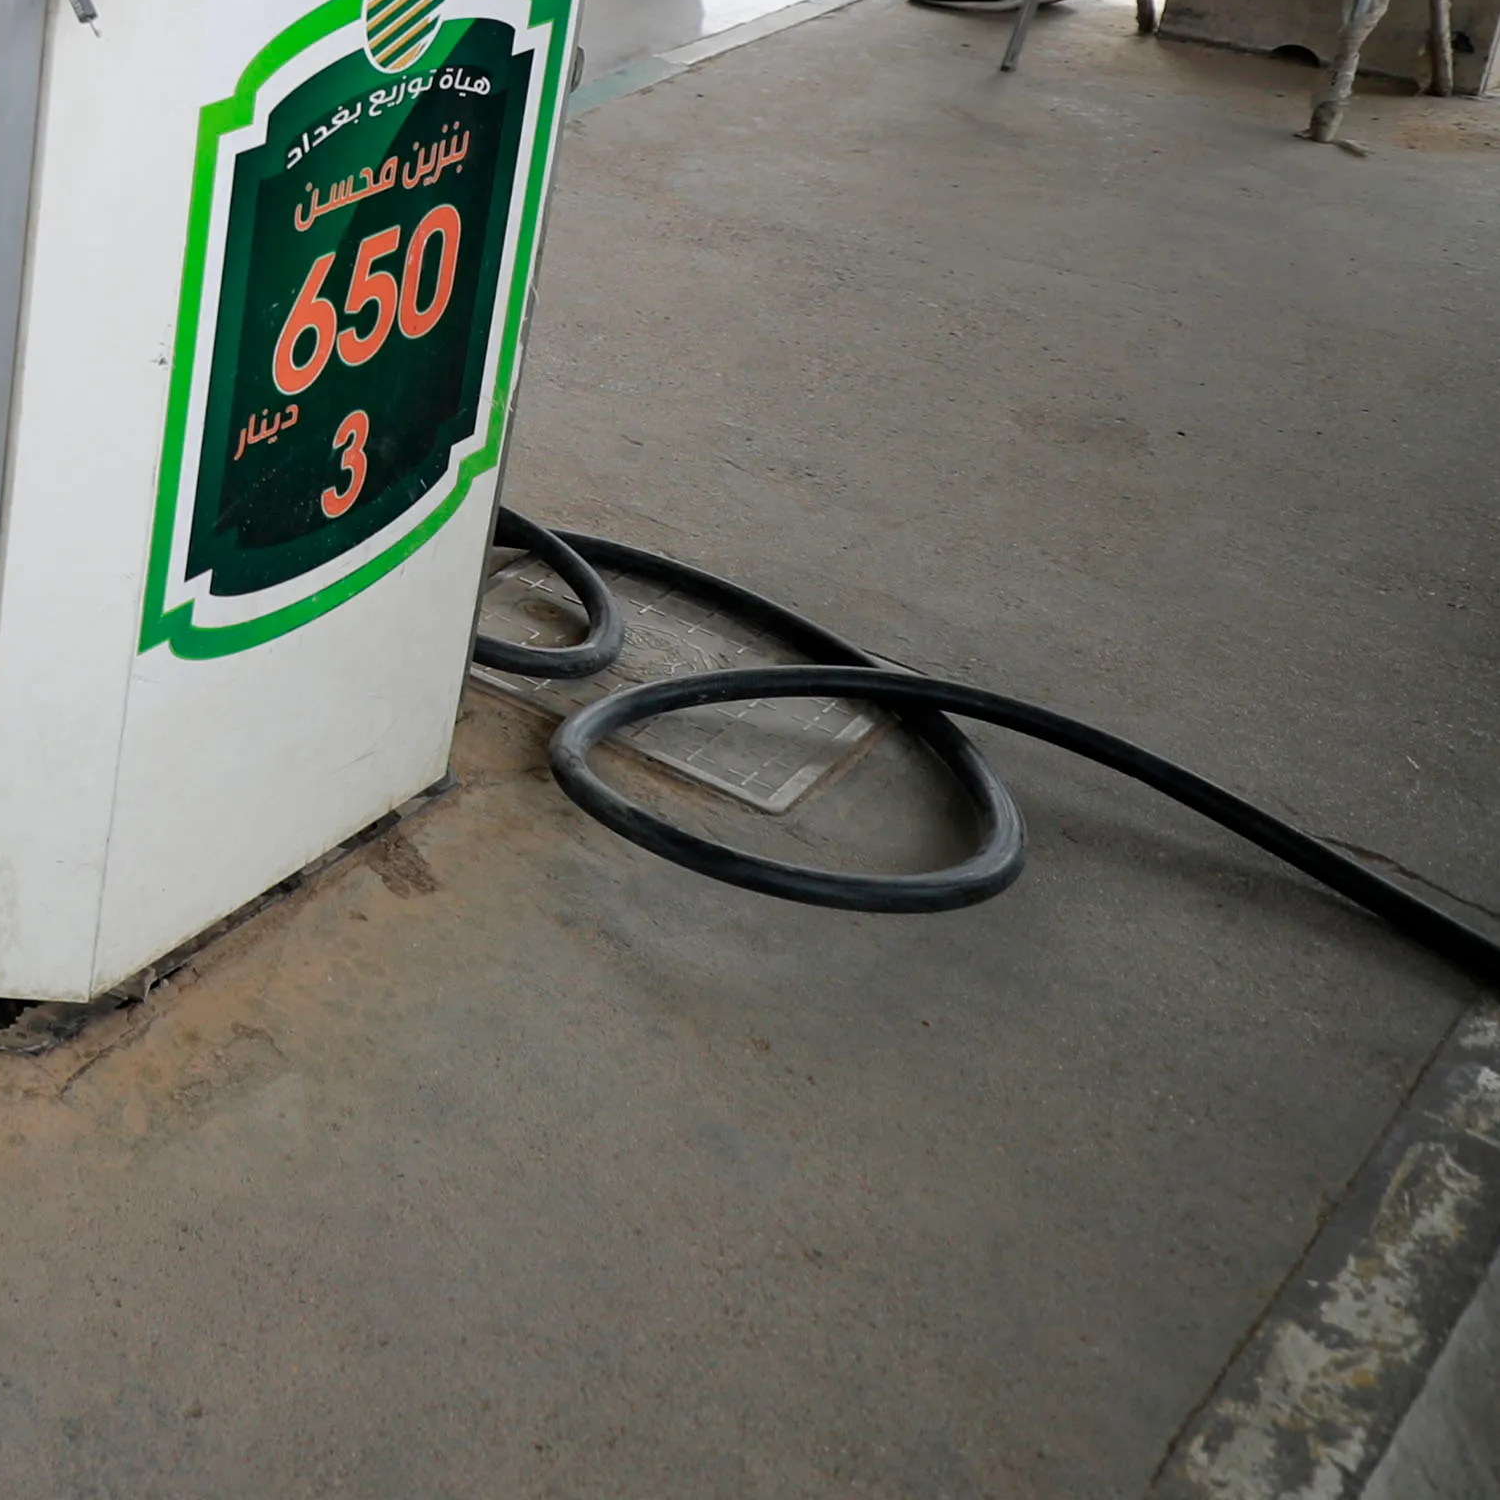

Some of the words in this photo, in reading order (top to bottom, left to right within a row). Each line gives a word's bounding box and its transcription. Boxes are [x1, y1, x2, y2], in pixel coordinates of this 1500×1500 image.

[368, 68, 437, 117] توزيع
[285, 101, 362, 170] بغداد
[402, 120, 470, 190] بنزين
[293, 155, 399, 233] محسن
[271, 203, 461, 397] 650
[233, 403, 299, 461] دينار
[320, 409, 371, 519] 3
